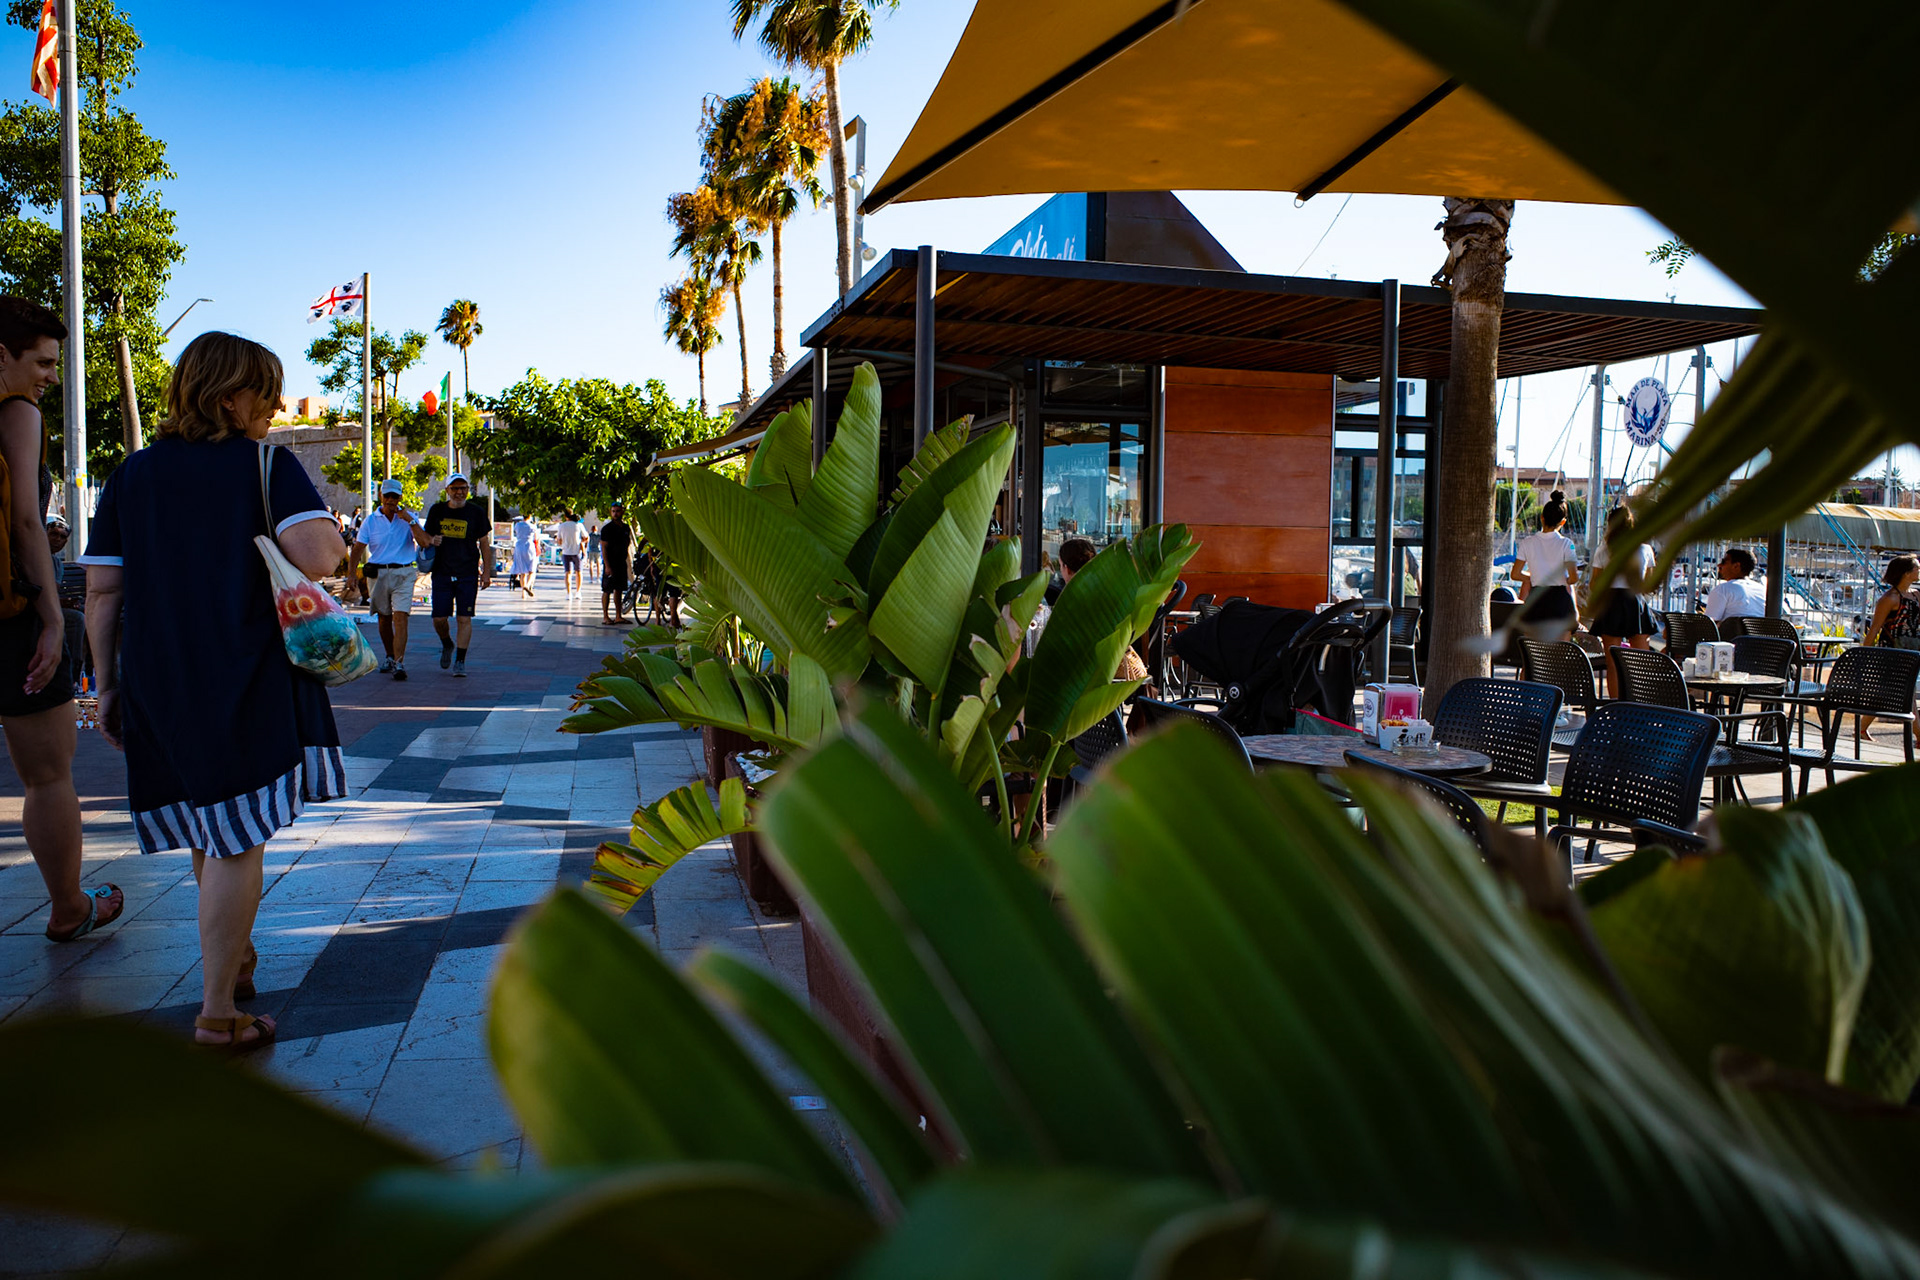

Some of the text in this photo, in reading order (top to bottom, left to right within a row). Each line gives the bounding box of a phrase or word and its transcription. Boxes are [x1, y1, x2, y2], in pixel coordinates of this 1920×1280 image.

[1625, 378, 1668, 408] MAR DE PLATA
[1625, 420, 1657, 446] MARINA
